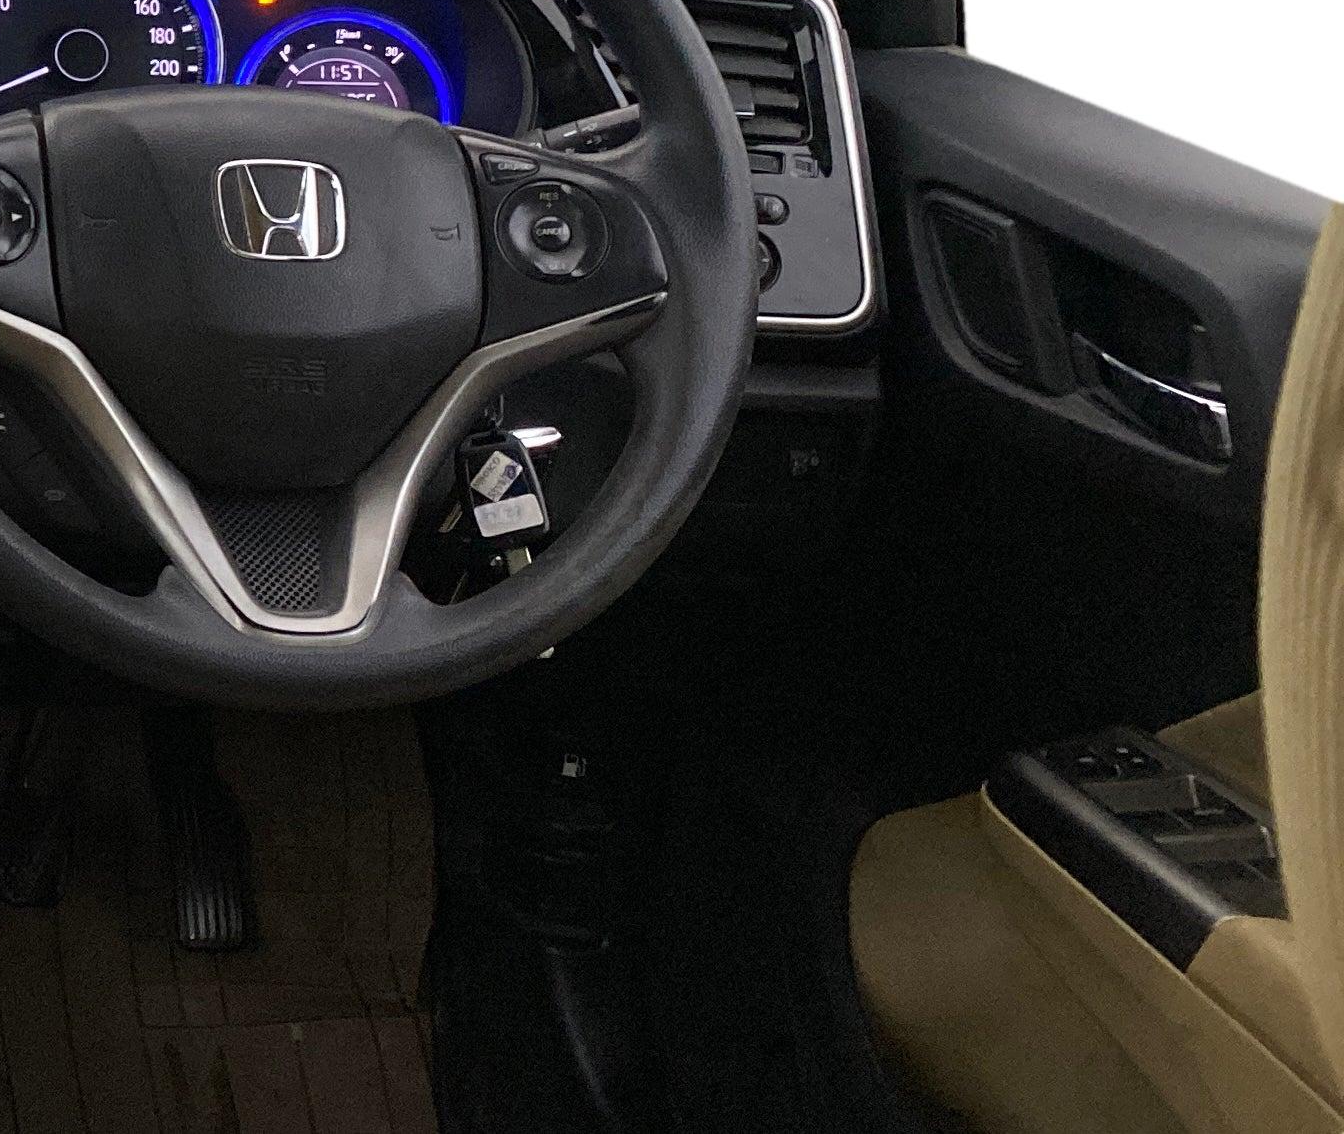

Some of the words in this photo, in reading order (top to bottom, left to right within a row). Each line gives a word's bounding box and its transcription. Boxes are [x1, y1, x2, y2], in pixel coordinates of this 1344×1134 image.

[134, 0, 160, 16] 160
[149, 28, 176, 45] 180
[384, 46, 398, 57] 30
[150, 59, 180, 76] 200
[320, 64, 363, 81] 11:57
[539, 191, 560, 201] RES
